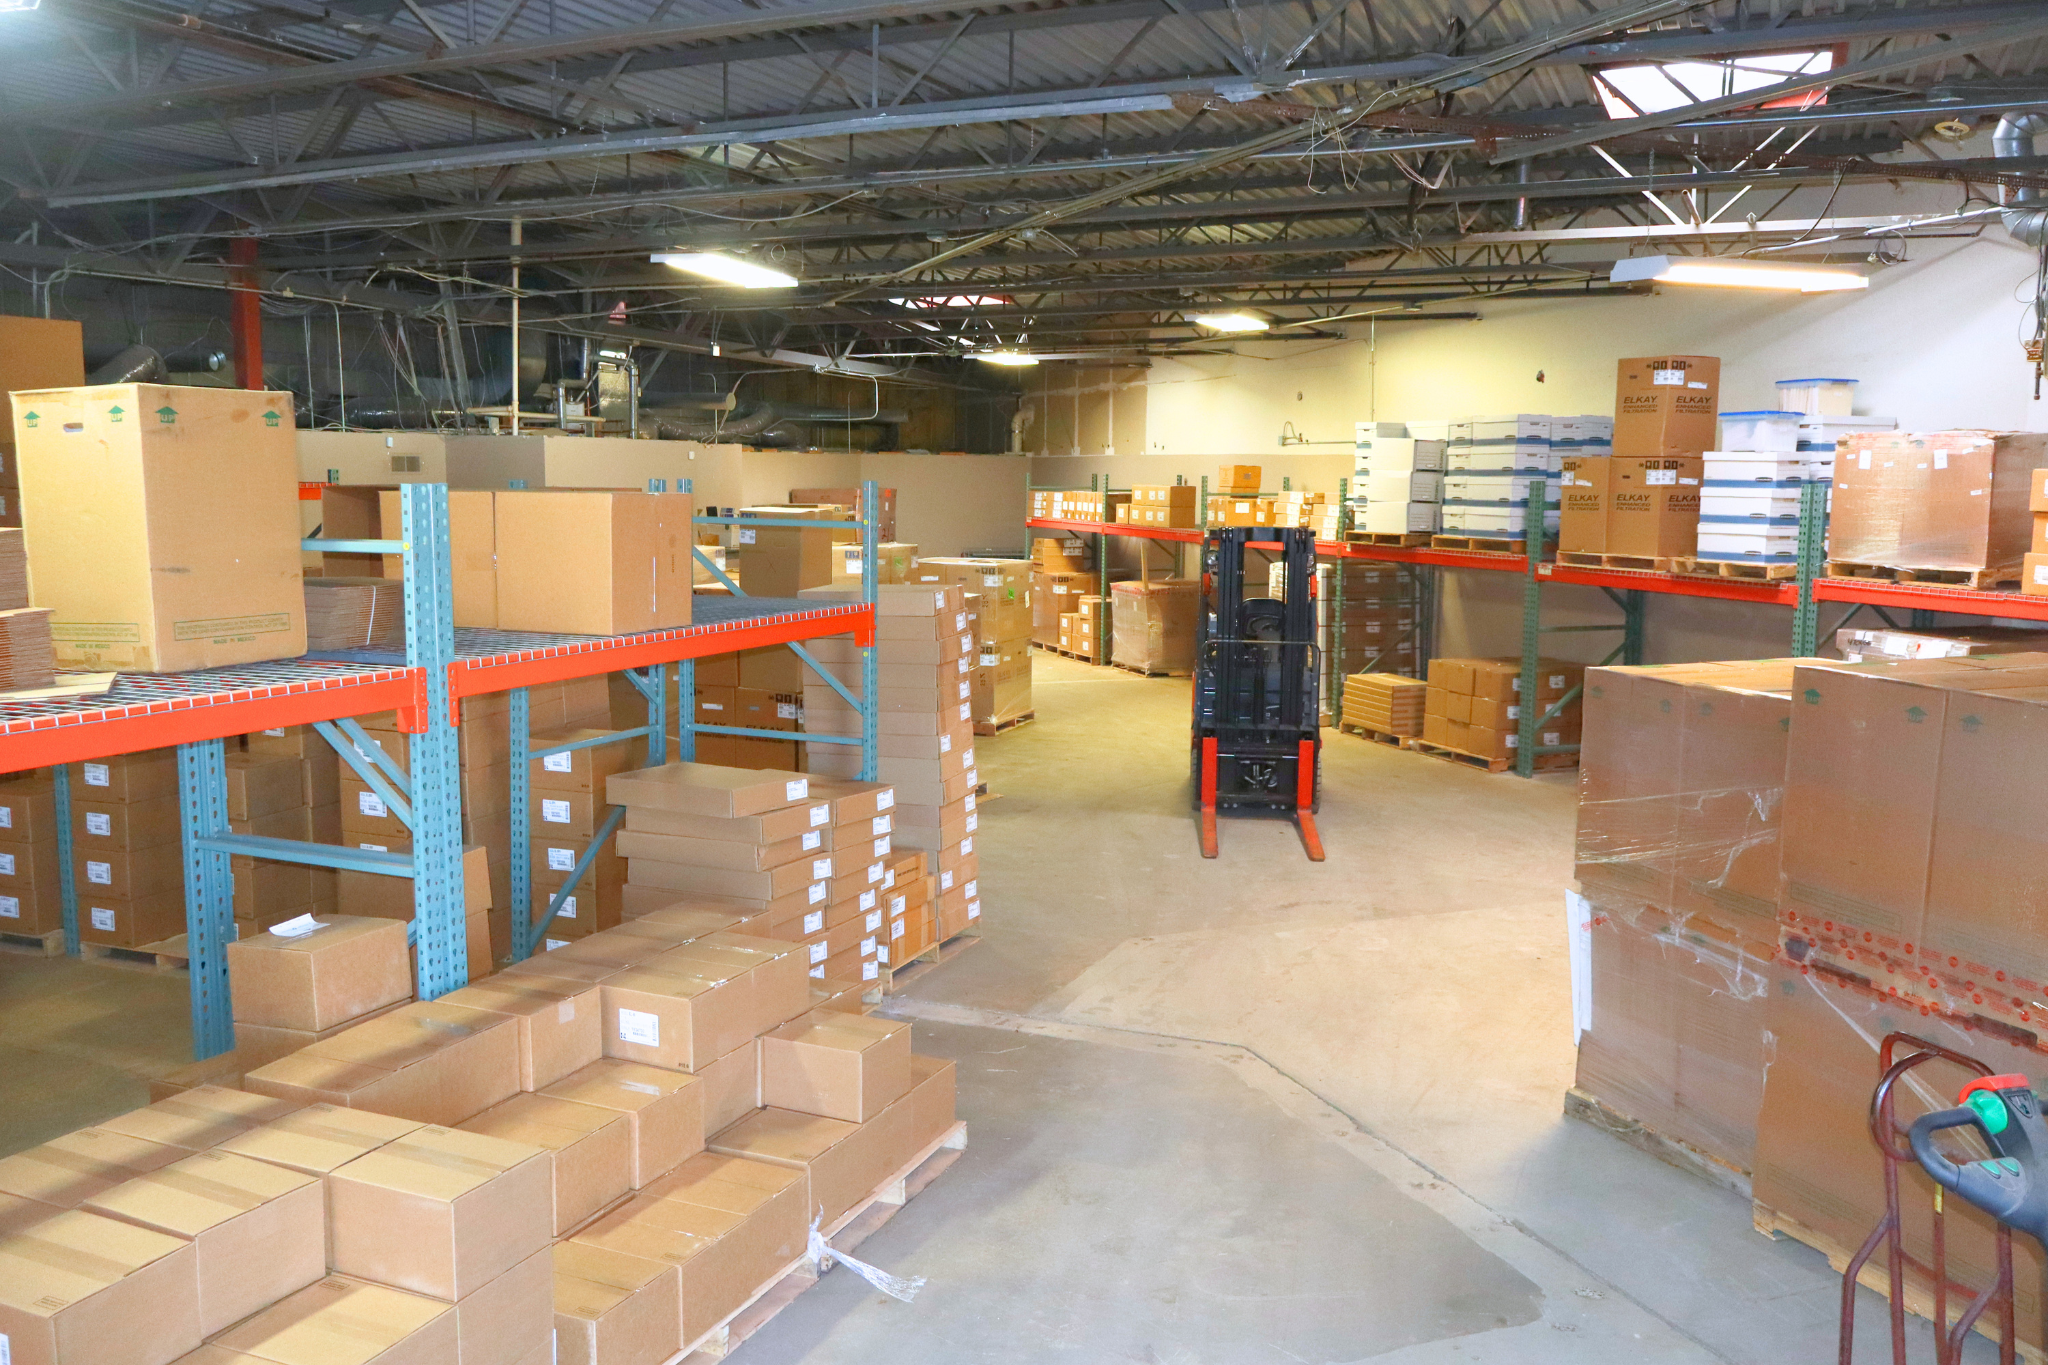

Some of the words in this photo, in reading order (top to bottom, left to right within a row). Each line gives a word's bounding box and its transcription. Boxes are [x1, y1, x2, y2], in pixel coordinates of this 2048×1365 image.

[1623, 396, 1658, 404] ELKAY
[1676, 396, 1712, 404] ELKAY
[161, 414, 174, 422] UP
